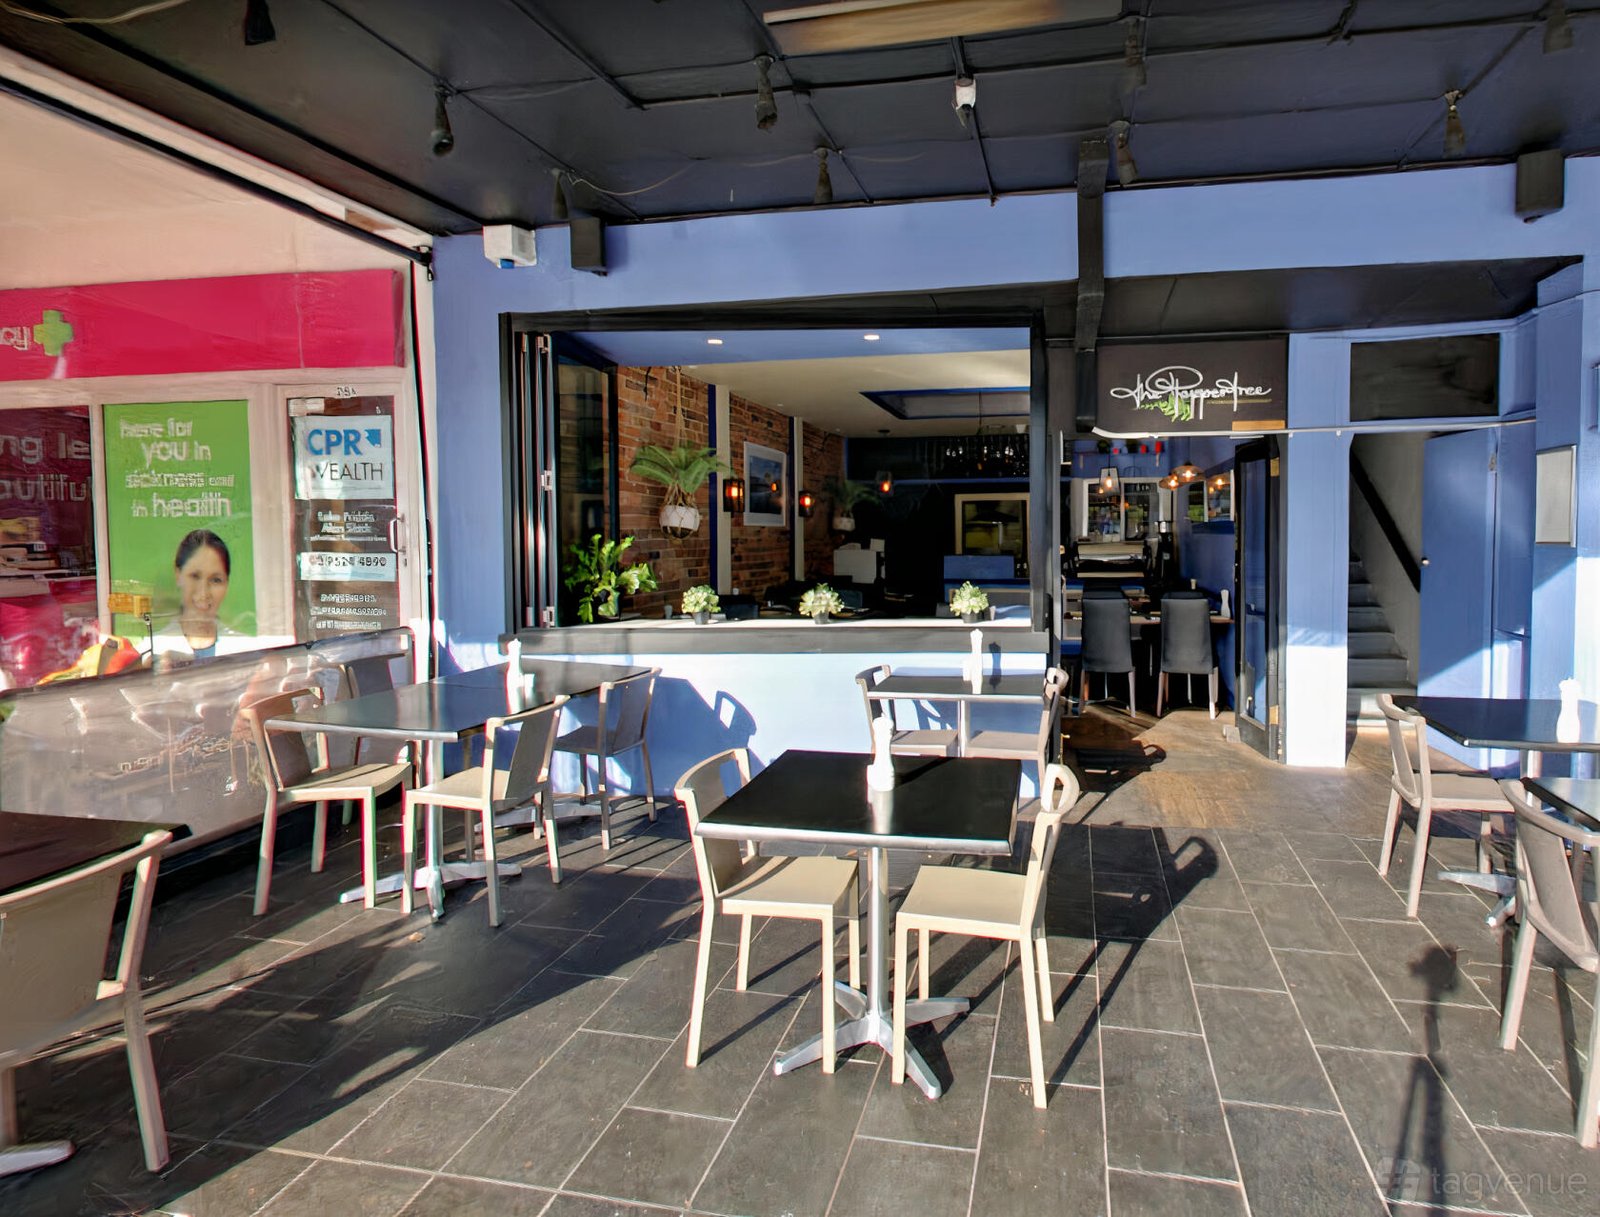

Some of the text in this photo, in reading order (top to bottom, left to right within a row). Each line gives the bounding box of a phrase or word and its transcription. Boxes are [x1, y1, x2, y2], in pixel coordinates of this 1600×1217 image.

[140, 440, 212, 469] you in
[306, 428, 363, 456] CPR
